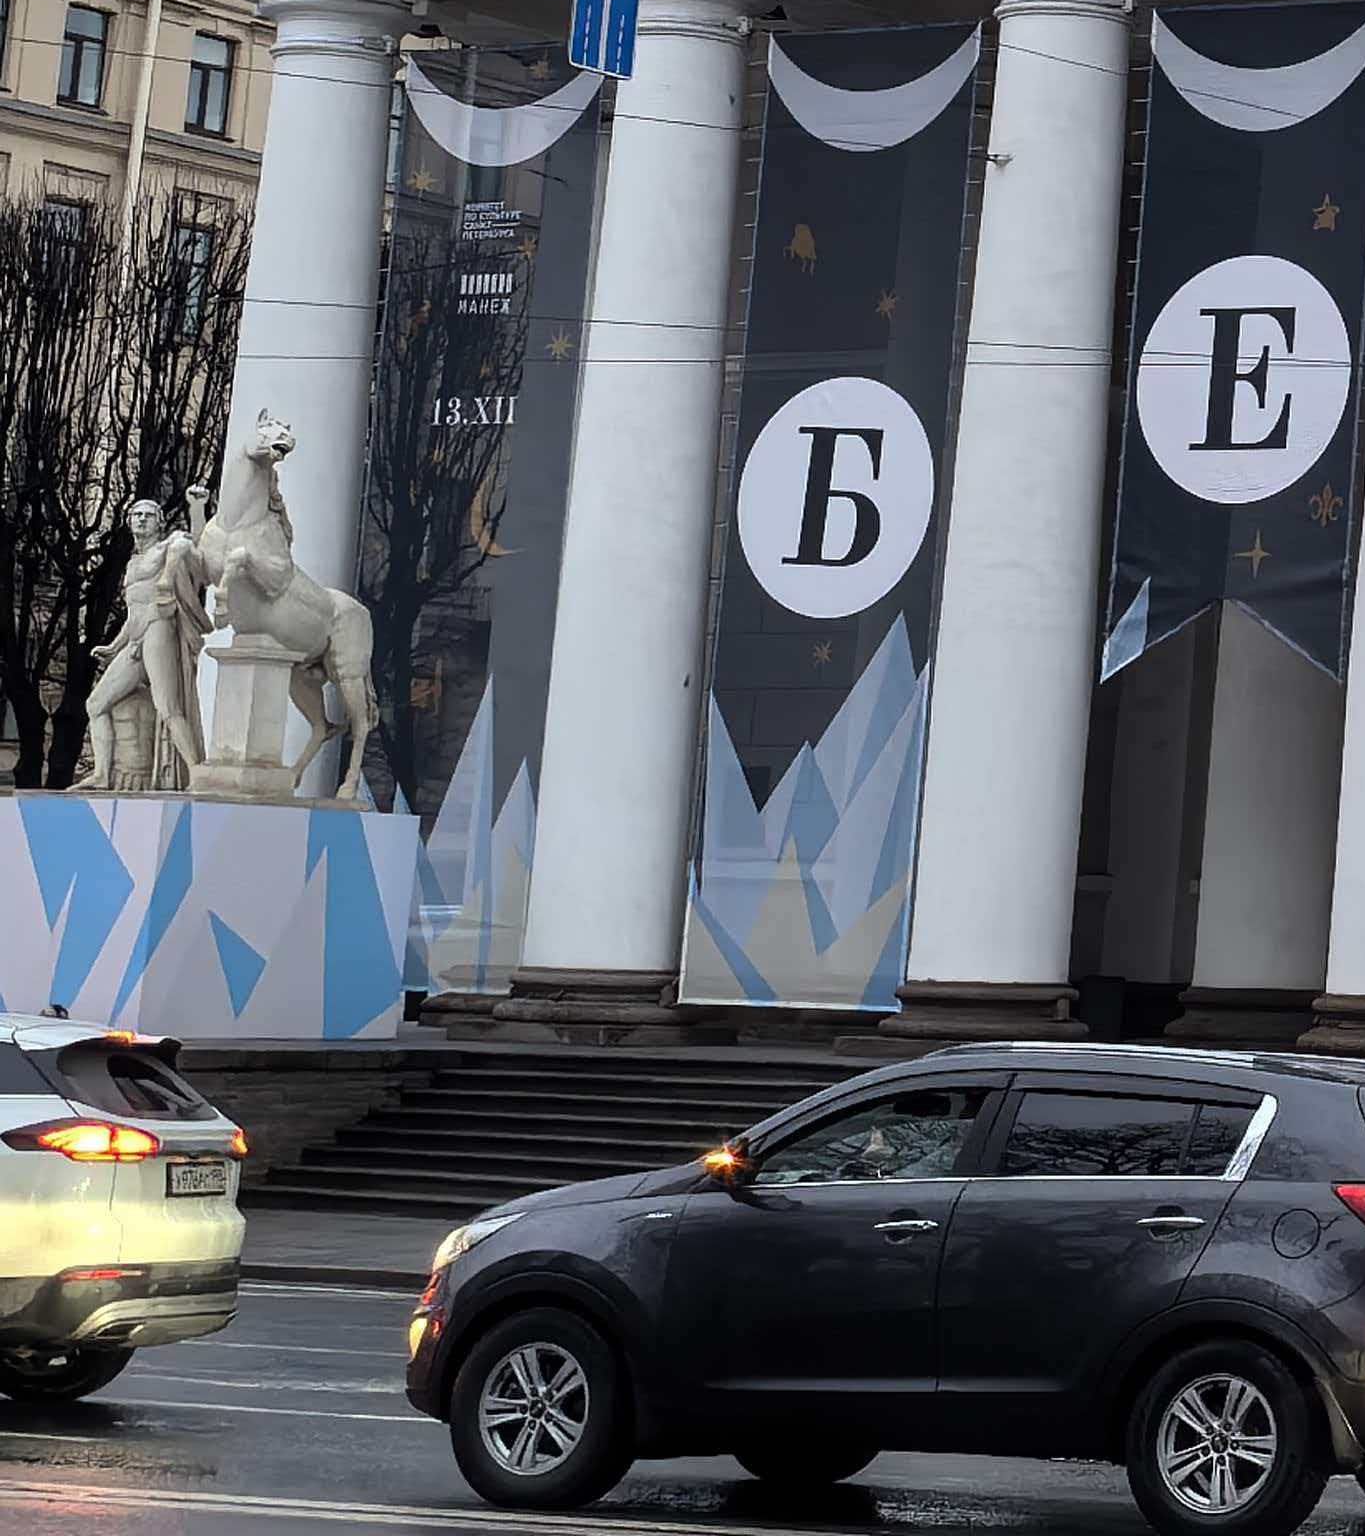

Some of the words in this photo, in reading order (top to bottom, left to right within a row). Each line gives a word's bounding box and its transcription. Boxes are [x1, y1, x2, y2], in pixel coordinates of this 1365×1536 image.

[457, 297, 511, 314] МАНЕЖ
[431, 395, 519, 426] 13.XII
[1187, 306, 1297, 452] Е
[781, 426, 885, 568] Б
